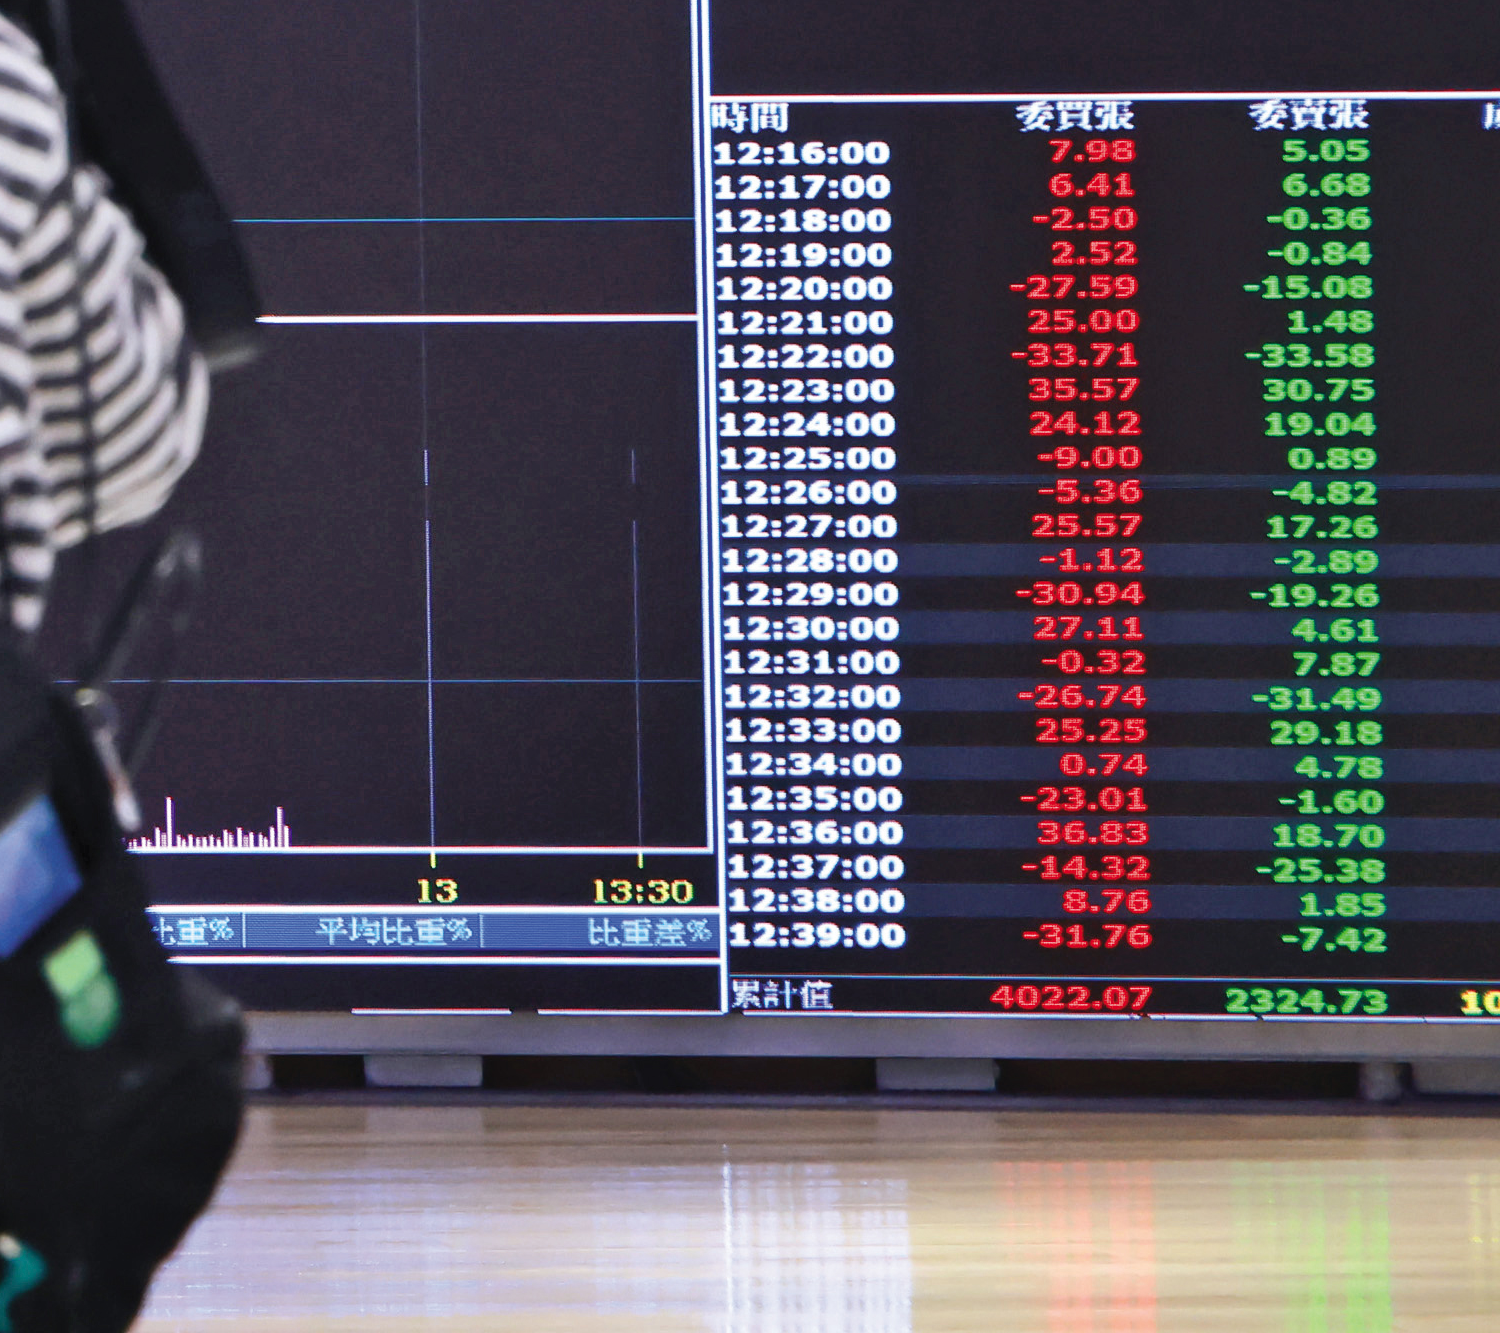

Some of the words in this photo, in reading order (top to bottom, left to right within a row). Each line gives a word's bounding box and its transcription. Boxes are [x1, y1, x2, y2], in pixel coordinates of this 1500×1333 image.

[709, 102, 789, 132] 時間
[714, 142, 889, 164] 12:16:00
[1049, 139, 1136, 163] 7.98
[1283, 139, 1370, 162] 5.05
[717, 277, 892, 300] 12:20:00
[1010, 274, 1138, 299] -27.59
[1243, 275, 1373, 299] -15.08
[720, 412, 895, 436] 12:24:00
[1030, 411, 1141, 435] 24.12
[1265, 412, 1376, 436] 19.04
[726, 718, 901, 742] 12:33:00
[1036, 718, 1147, 743] 25.25
[1271, 720, 1383, 745] 29.18
[418, 879, 457, 901] 13
[595, 880, 692, 902] 13:30
[730, 923, 905, 947] 12:39:00
[1023, 924, 1152, 948] -31.76
[1282, 927, 1387, 952] -7.42
[990, 985, 1152, 1010] 4022.07
[1226, 988, 1388, 1014] 2324.73
